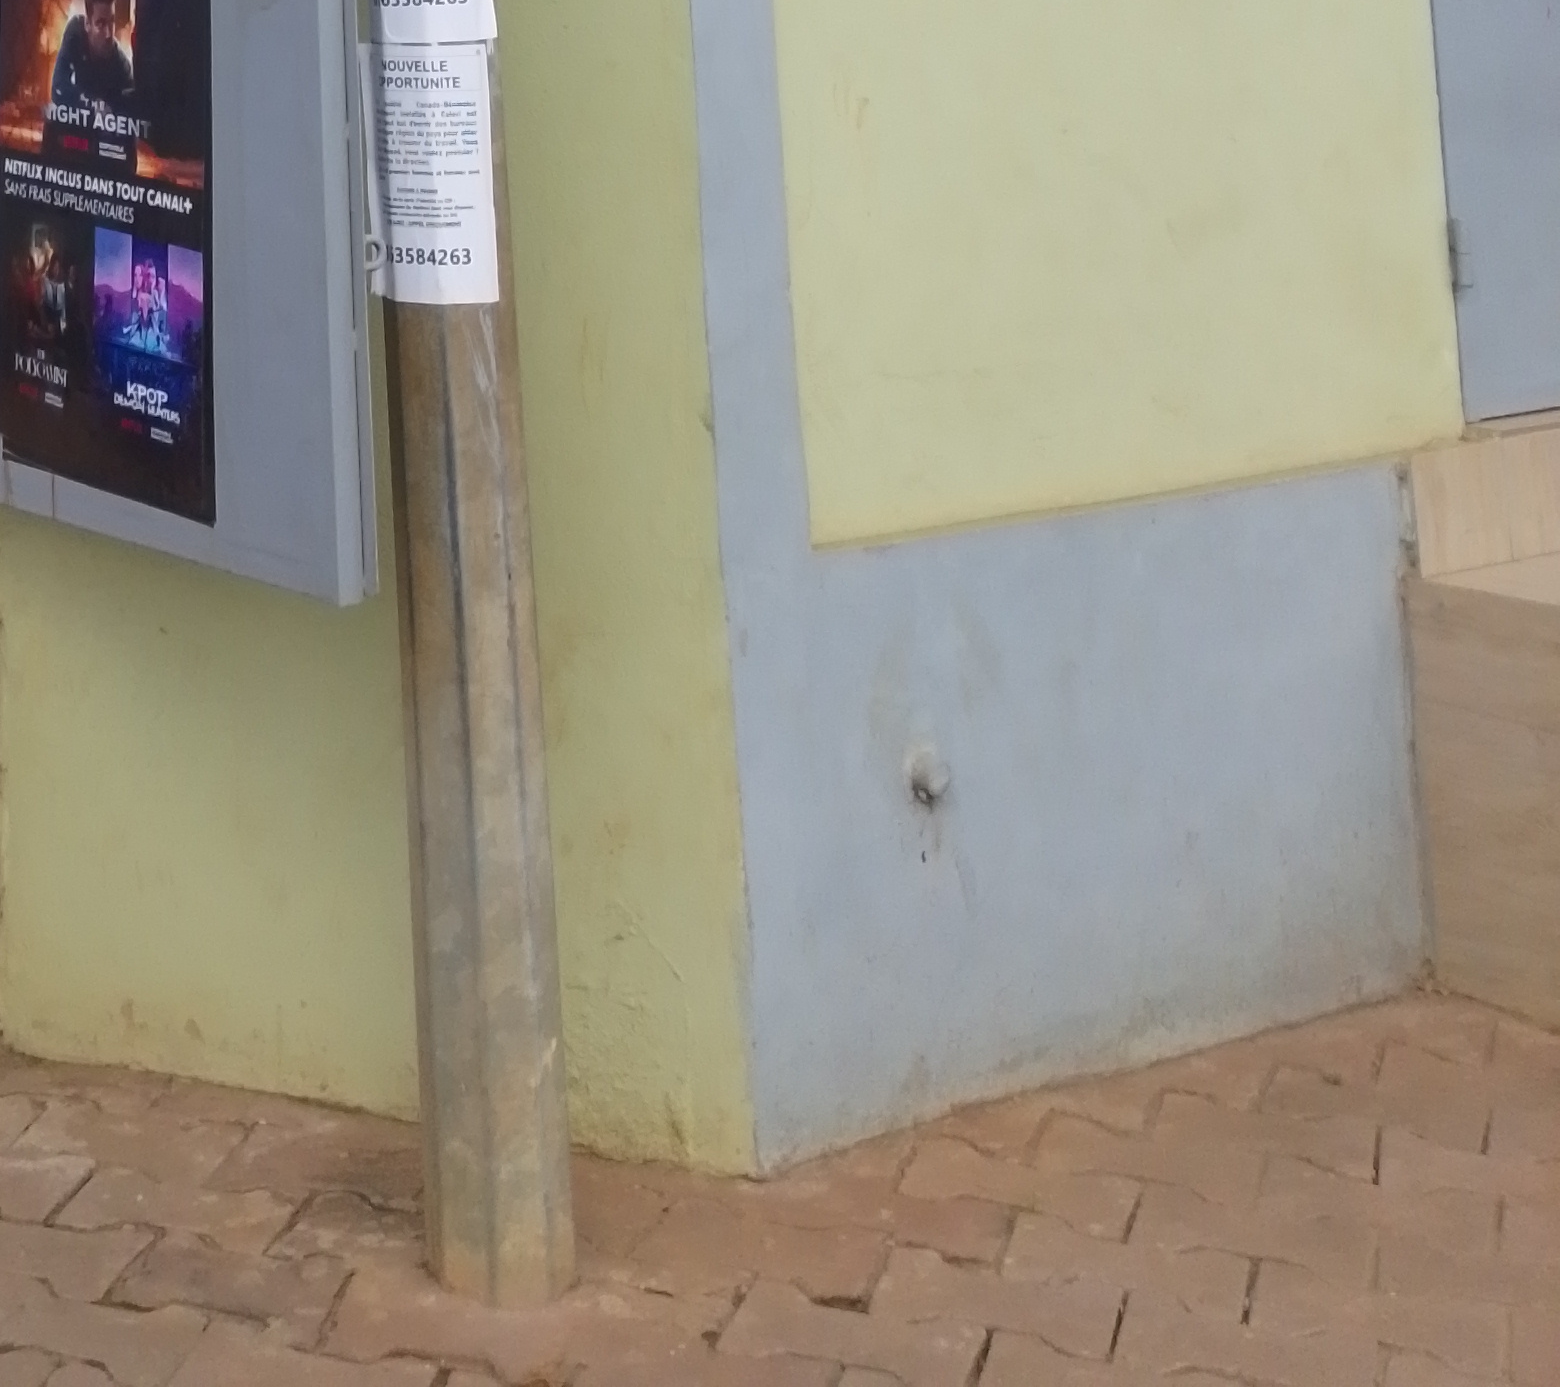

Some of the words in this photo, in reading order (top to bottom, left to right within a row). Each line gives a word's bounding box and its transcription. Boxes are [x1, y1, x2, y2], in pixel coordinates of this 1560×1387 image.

[93, 114, 151, 138] AGENT
[4, 158, 43, 180] NETFLIX
[45, 166, 81, 189] INCLUS
[84, 174, 113, 196] DANS
[116, 183, 145, 202] TOUT
[147, 191, 192, 214] CANAL+
[4, 179, 27, 200] SANS
[29, 185, 52, 204] FRAIS
